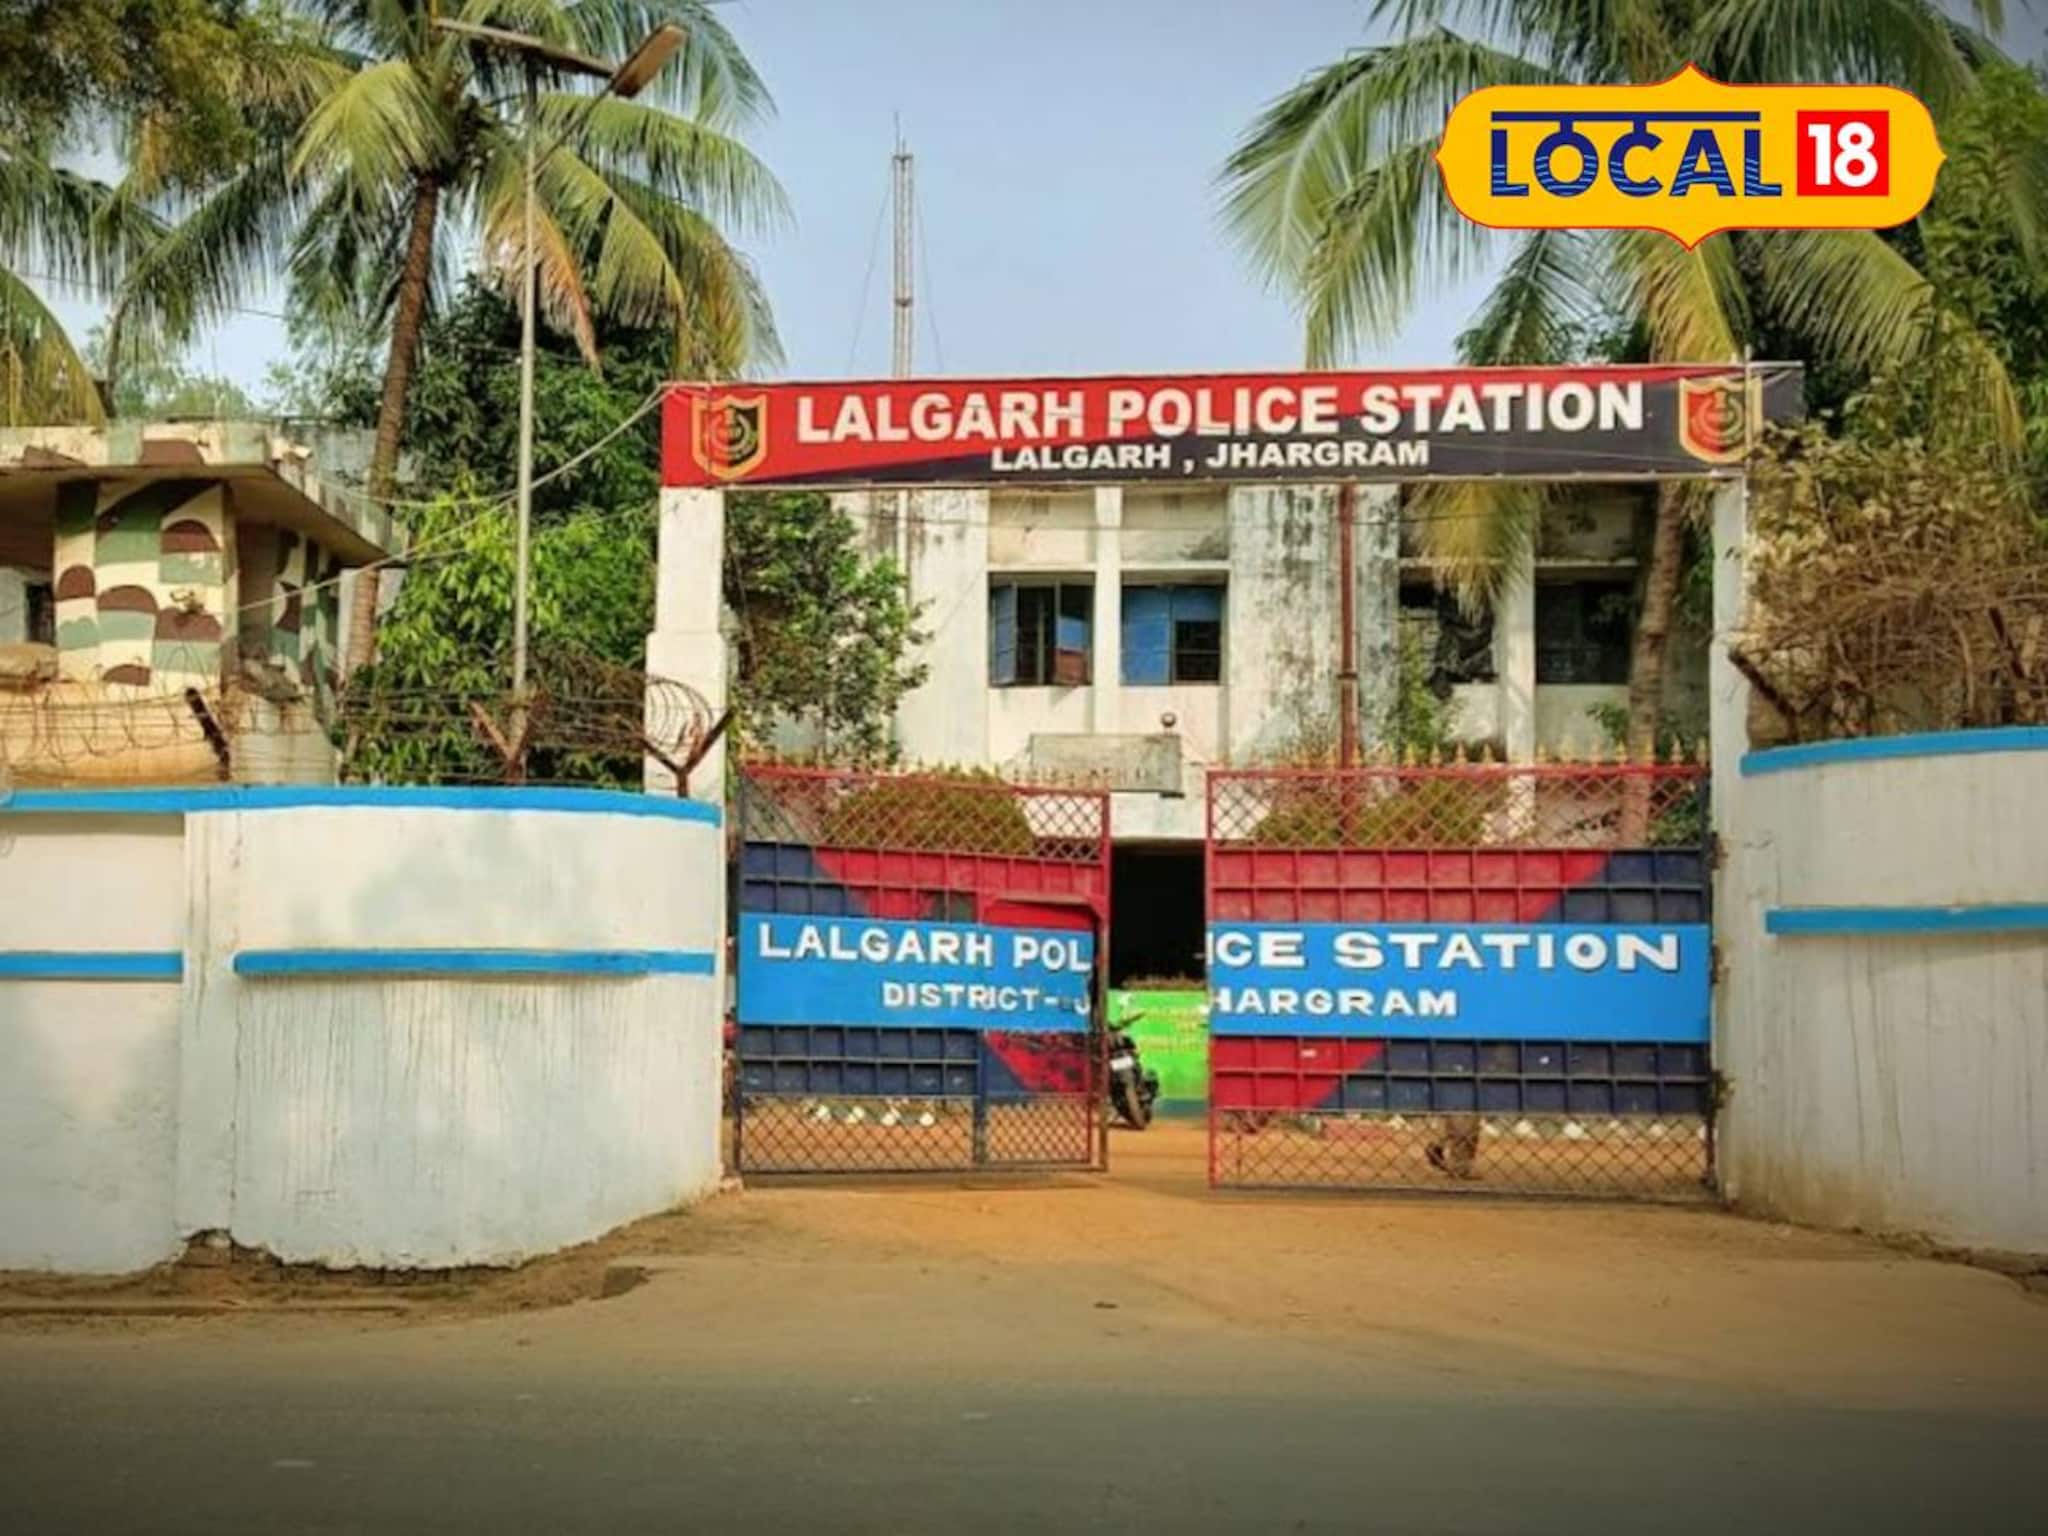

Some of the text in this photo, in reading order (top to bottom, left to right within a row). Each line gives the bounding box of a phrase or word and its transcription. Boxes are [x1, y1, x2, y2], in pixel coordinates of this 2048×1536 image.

[796, 379, 1644, 443] LALGARH POLICE STATION
[991, 443, 1172, 472] LALGARH
[1206, 439, 1429, 468] JHARGRAM
[758, 922, 1091, 972] LALGARH POL
[1333, 931, 1680, 971] STATION
